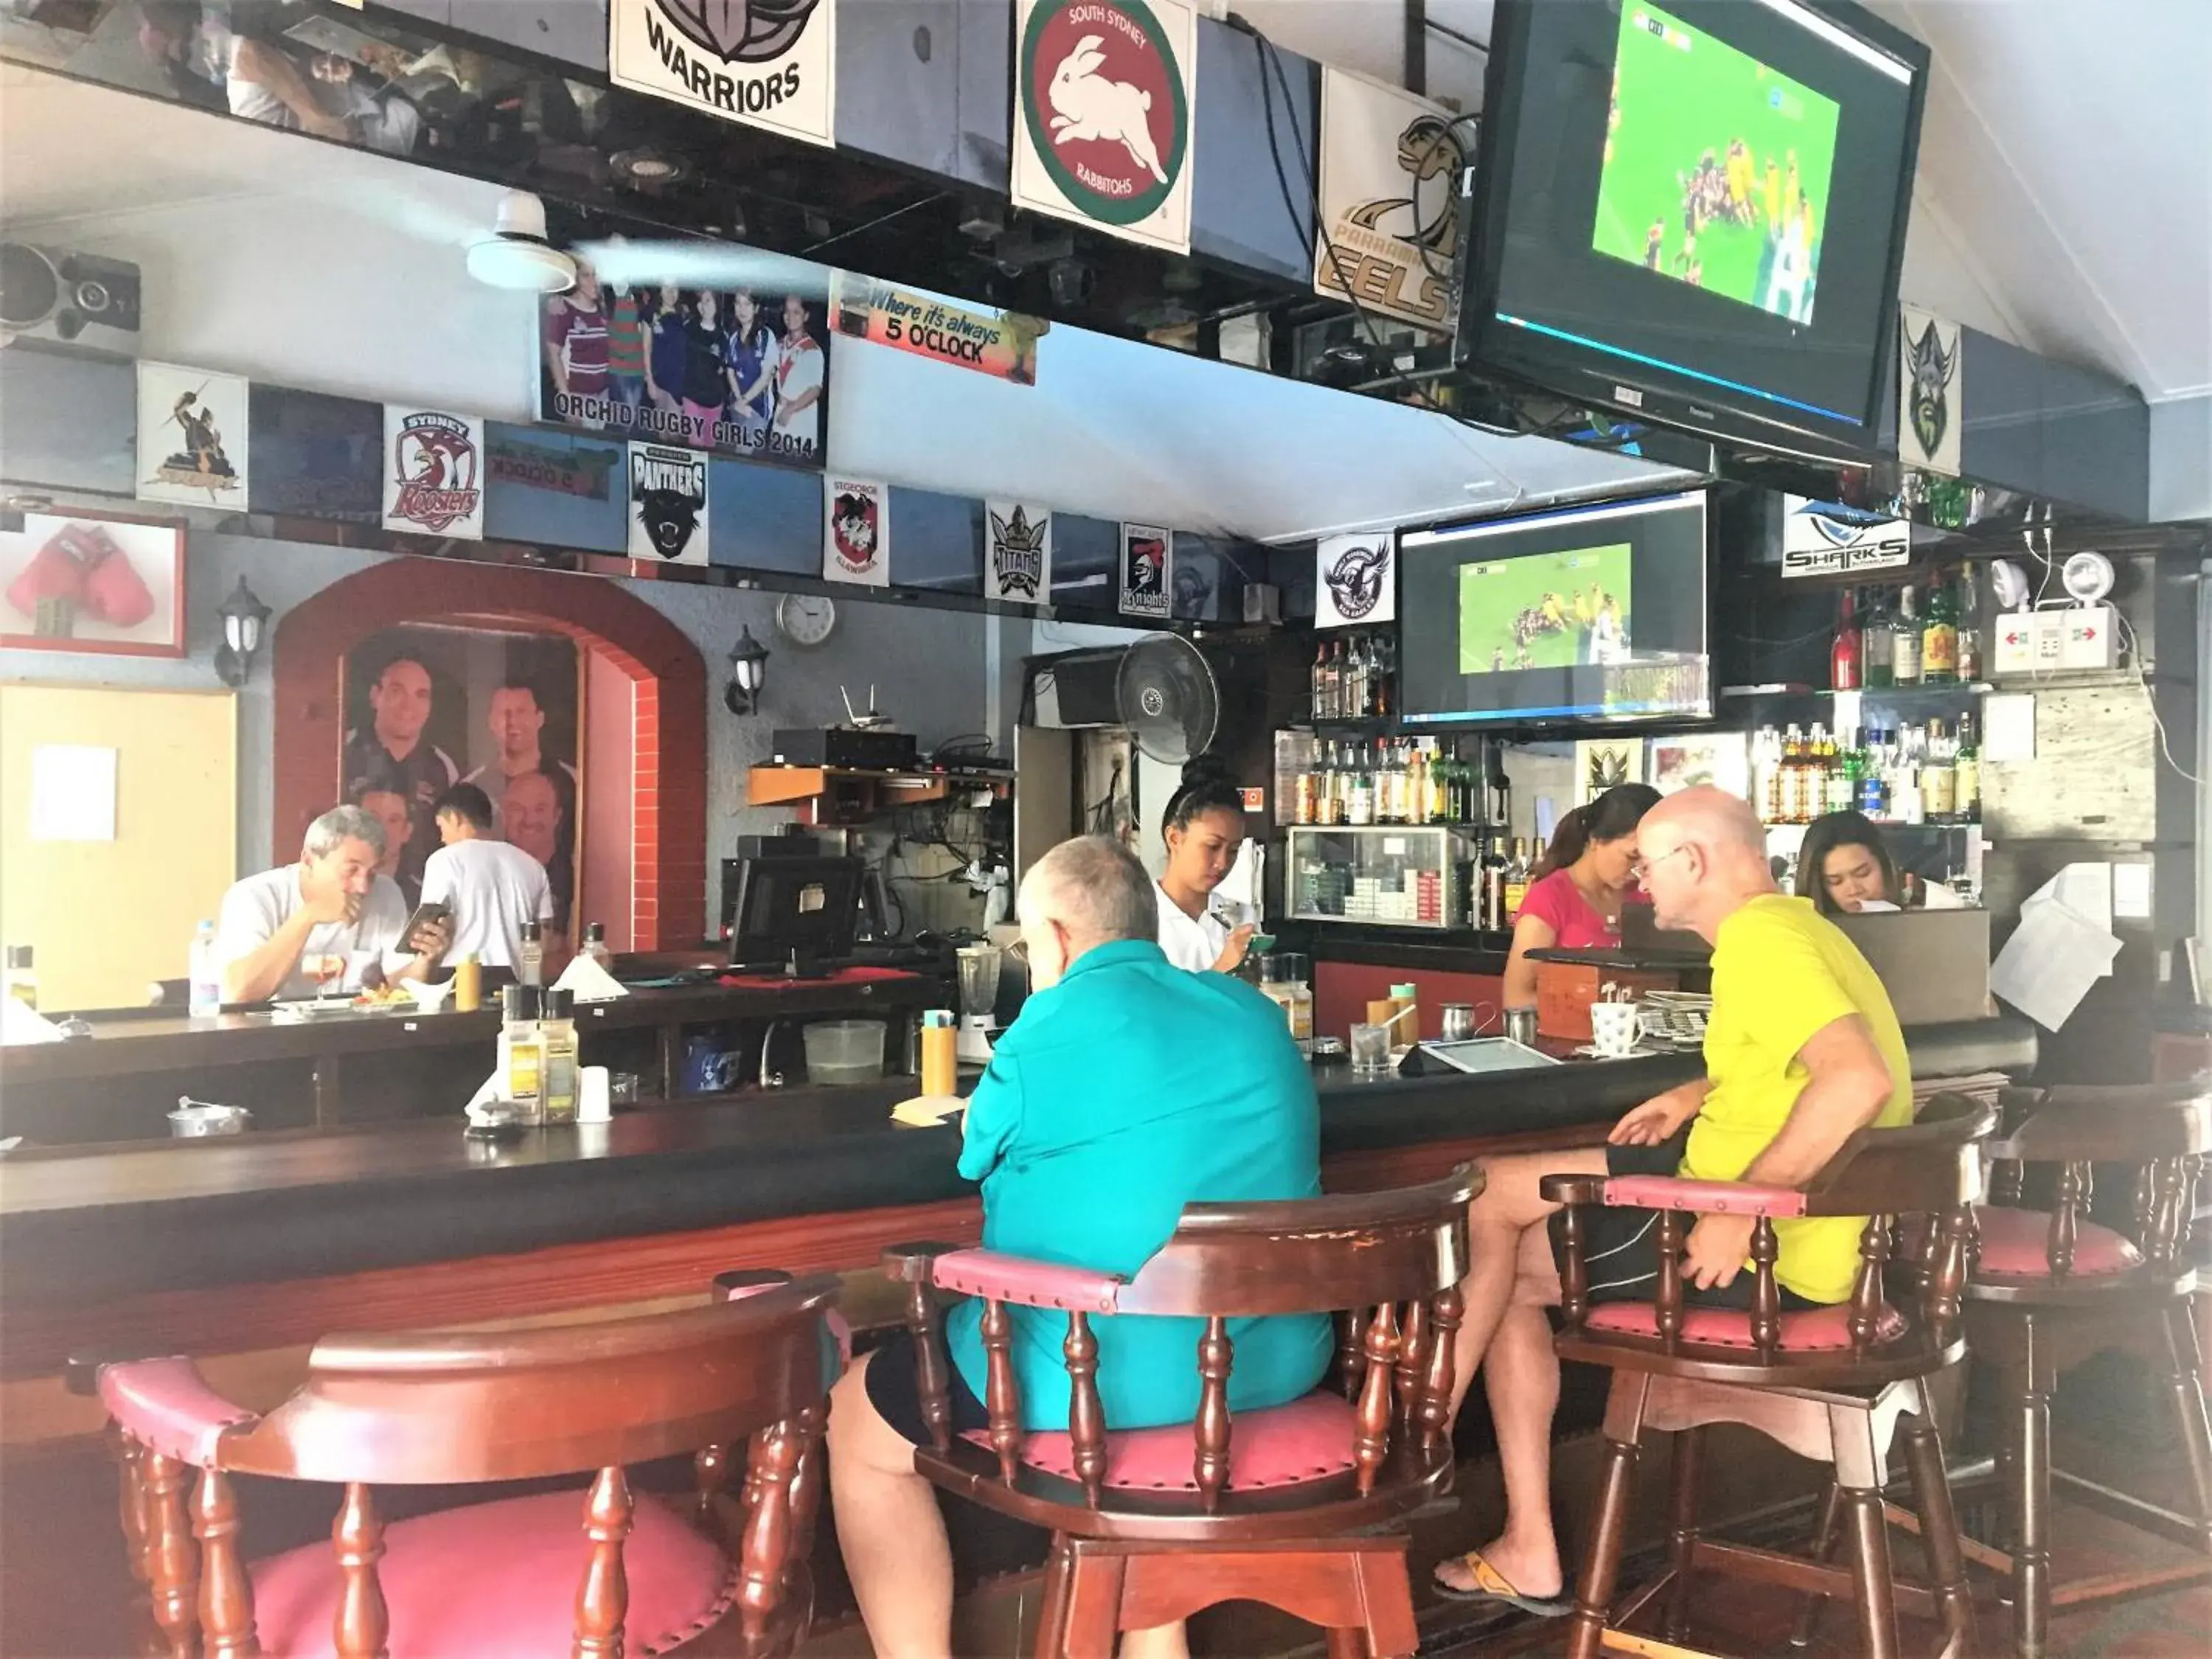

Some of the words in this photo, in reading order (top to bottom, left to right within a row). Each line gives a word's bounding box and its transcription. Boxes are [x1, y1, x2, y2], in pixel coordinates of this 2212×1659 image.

[1069, 5, 1105, 24] SOUTH
[1107, 10, 1147, 49] SYDNEY
[645, 7, 800, 114] WARRIORS
[1077, 162, 1133, 195] RABBITOHS
[1318, 244, 1454, 322] EELS
[869, 288, 920, 320] Where
[923, 303, 943, 327] it's
[947, 315, 1001, 344] always
[886, 317, 902, 340] 5
[909, 323, 983, 364] O'CLOCK
[408, 414, 467, 435] SYDNEY
[554, 393, 631, 425] ORCHID
[639, 407, 704, 436] RUGBY
[712, 420, 765, 449] GIRLS
[773, 433, 813, 457] 2014
[633, 454, 704, 499] PANTHERS
[1785, 538, 1907, 569] SHARKS
